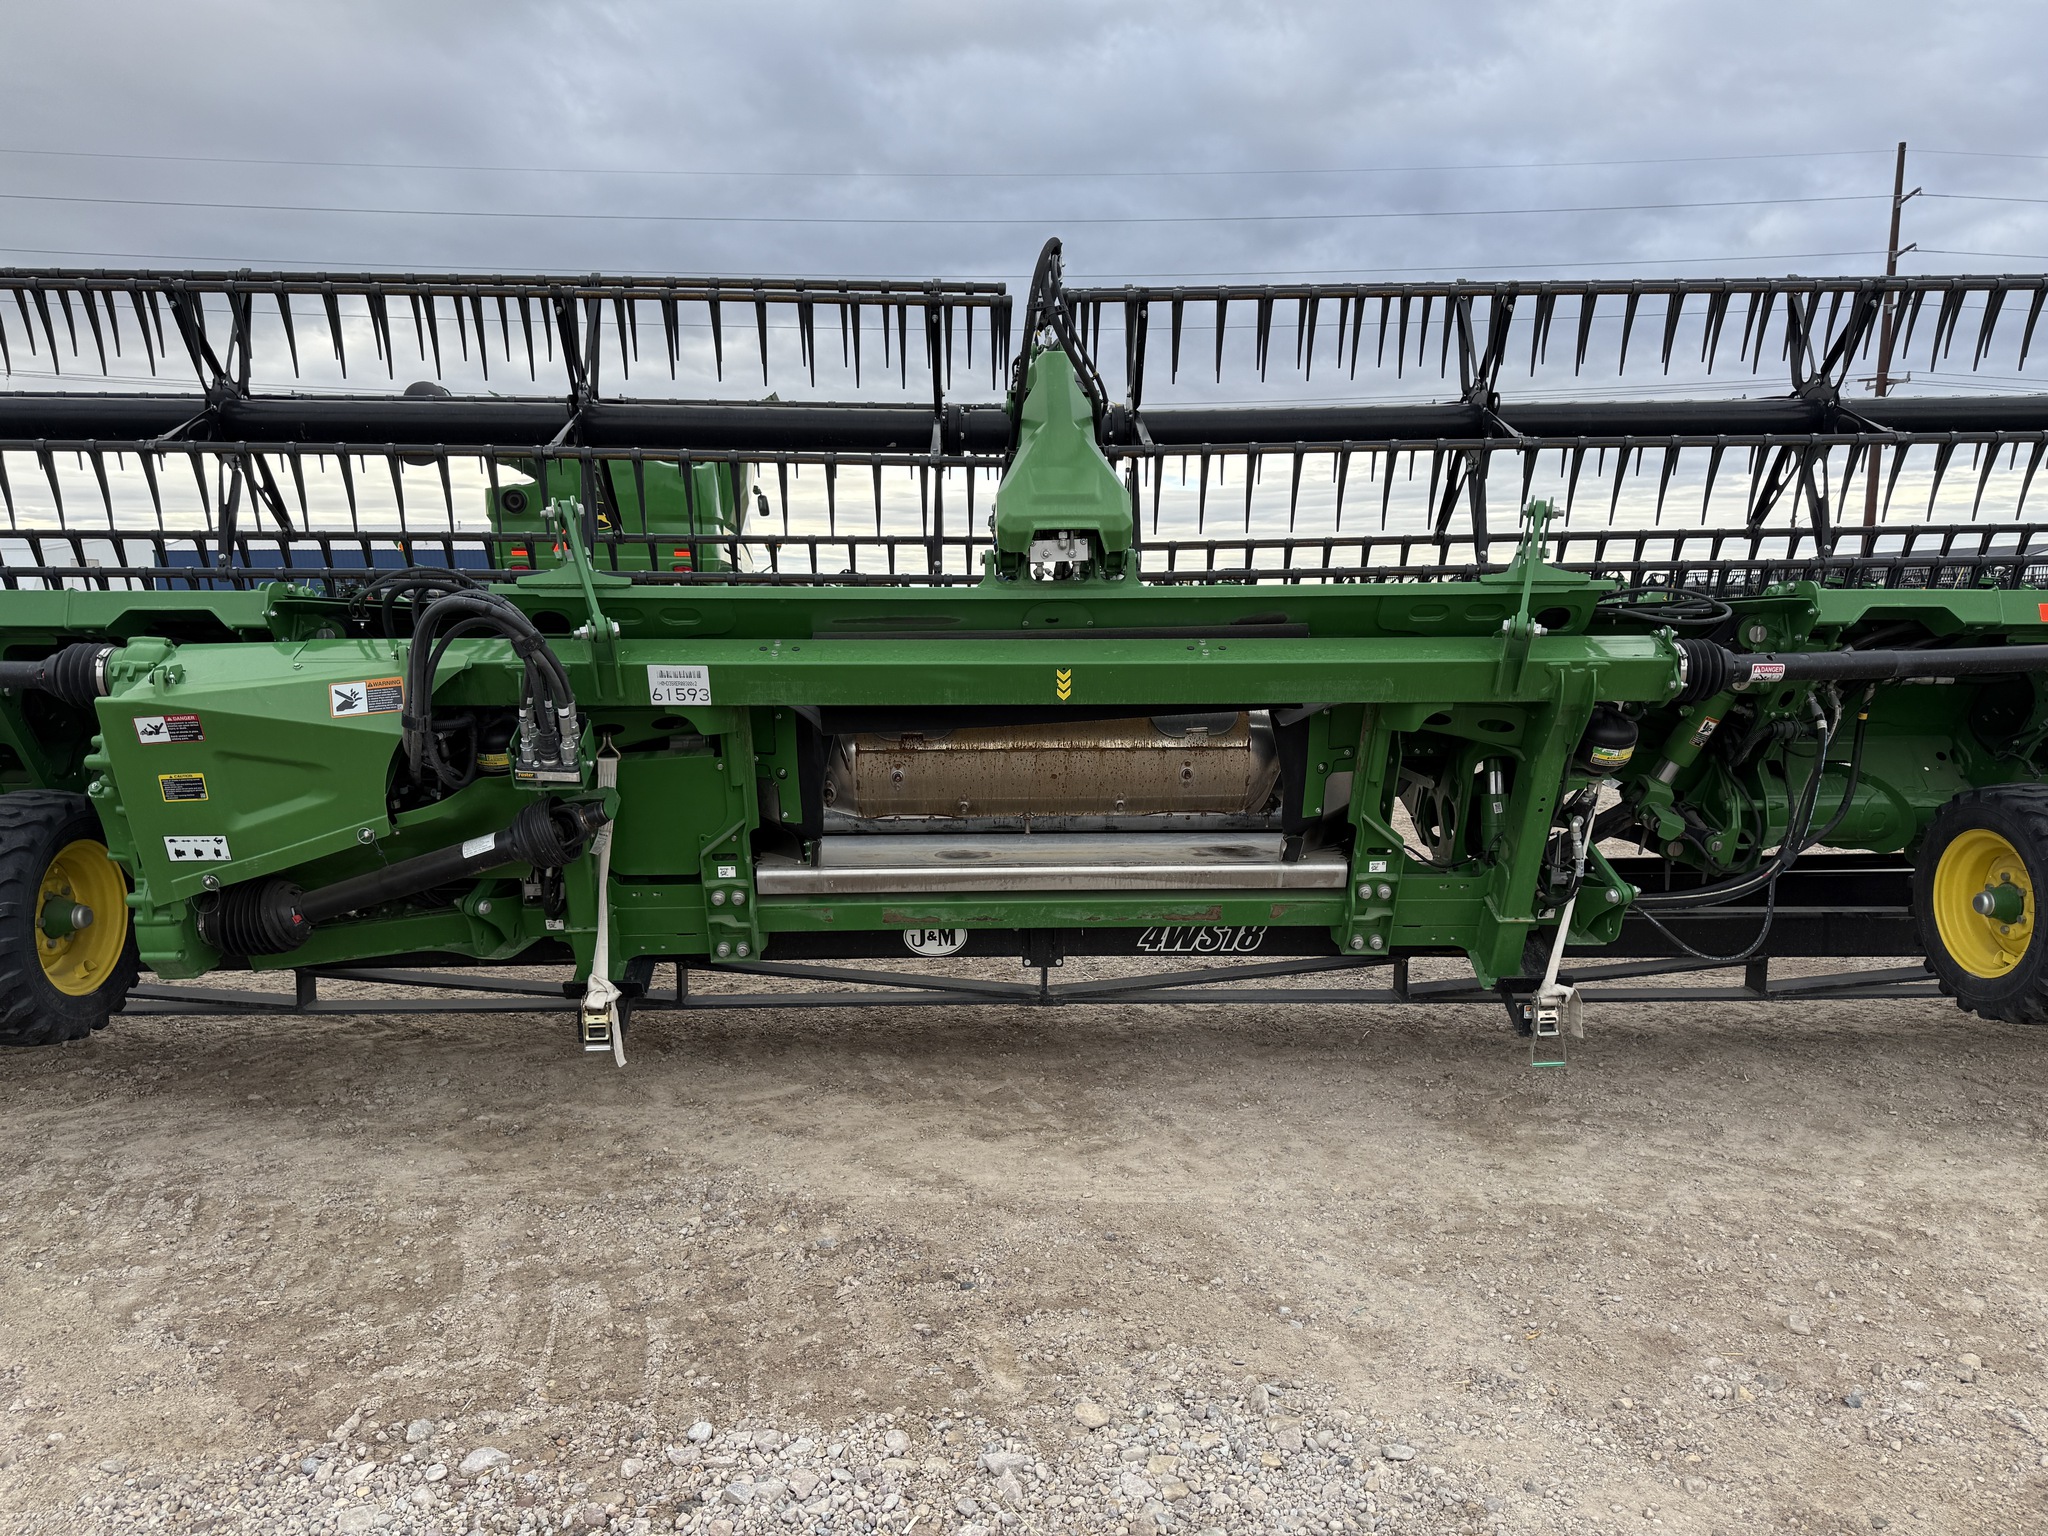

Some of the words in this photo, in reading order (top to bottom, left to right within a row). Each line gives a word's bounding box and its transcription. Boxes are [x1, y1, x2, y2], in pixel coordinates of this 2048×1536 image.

[373, 679, 401, 687] WARNING
[652, 687, 710, 702] 61593
[910, 928, 957, 948] J&M
[1136, 926, 1268, 952] 4WS18
